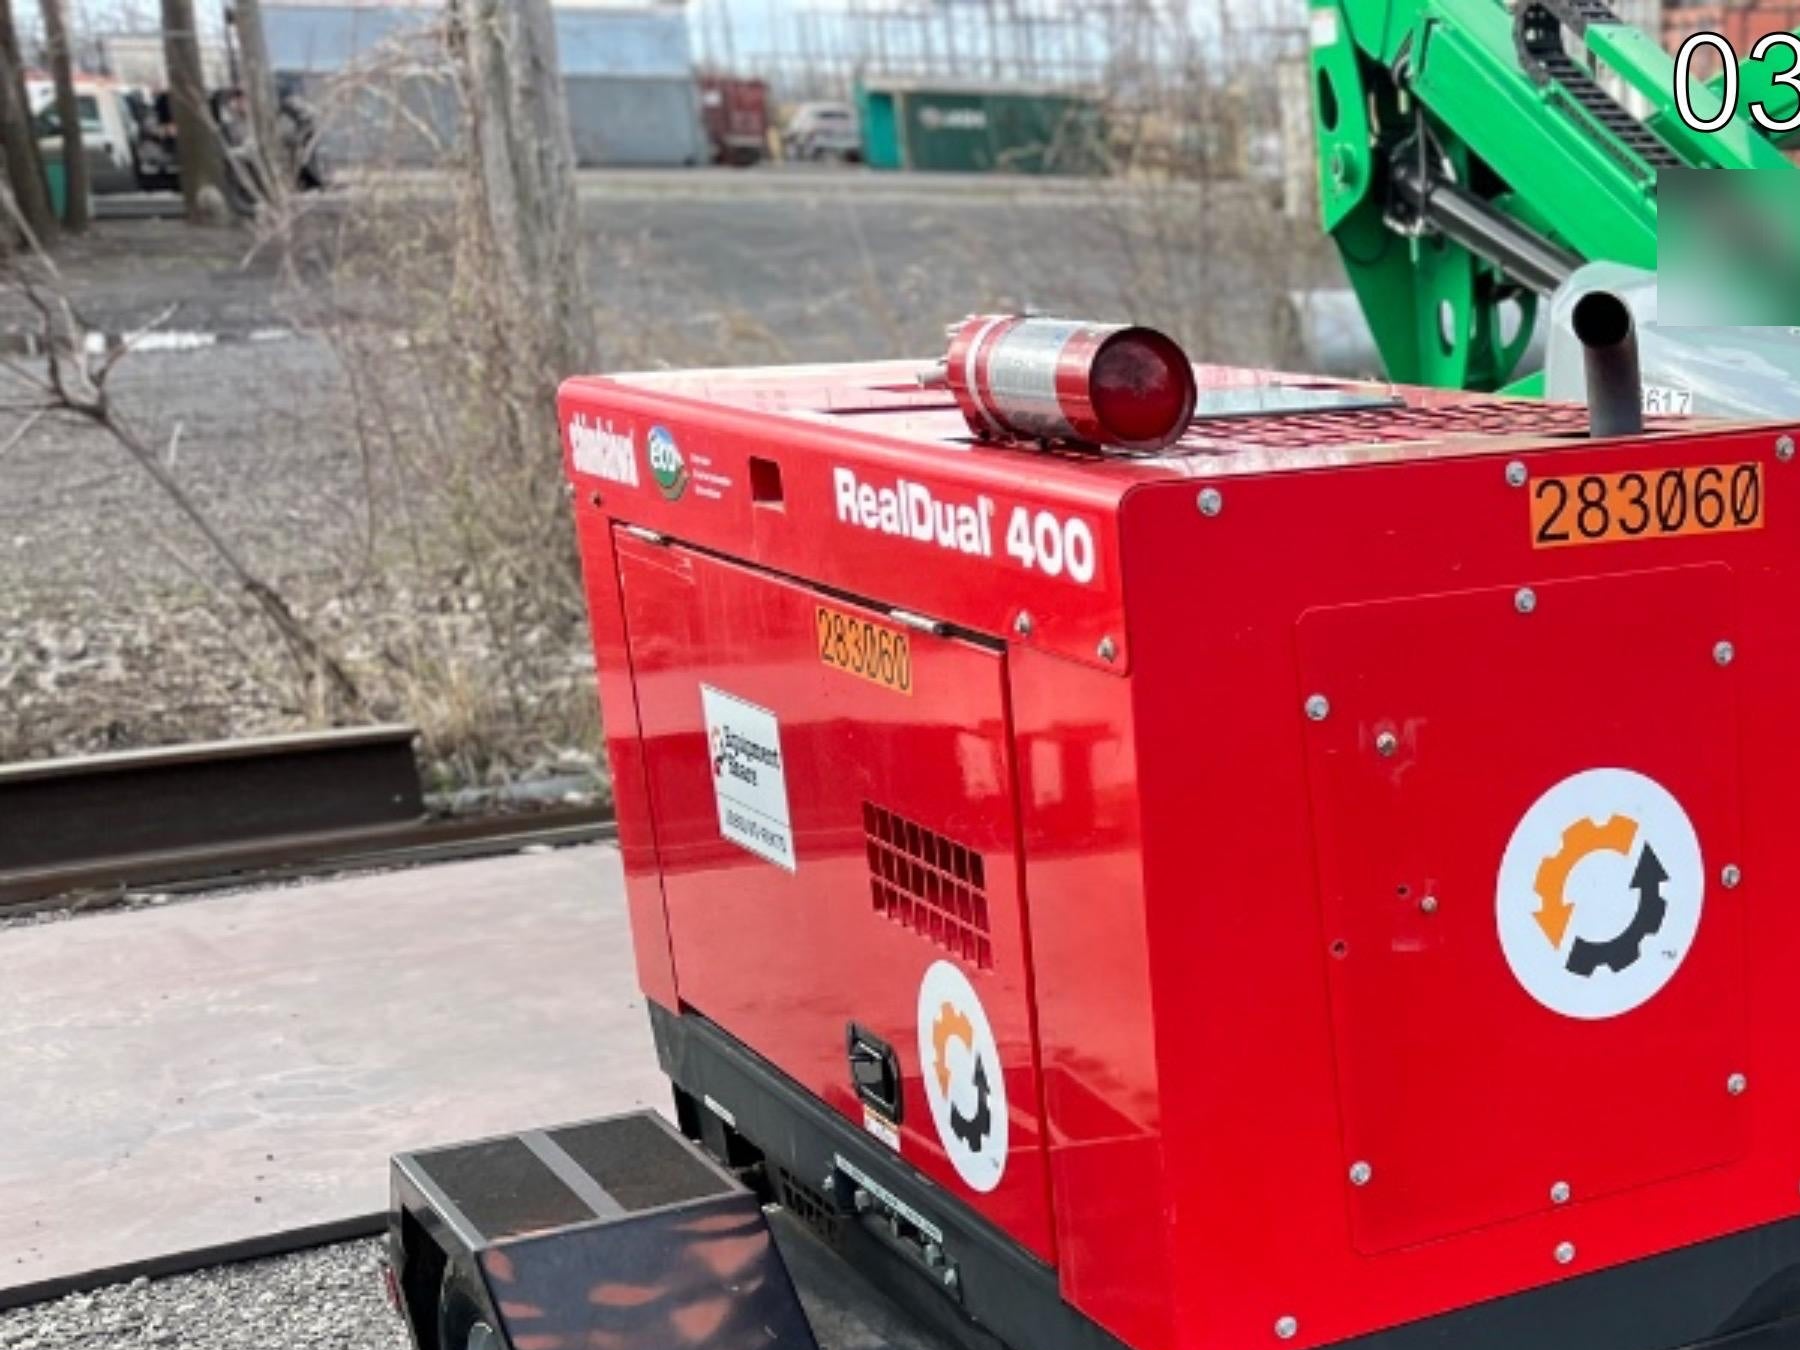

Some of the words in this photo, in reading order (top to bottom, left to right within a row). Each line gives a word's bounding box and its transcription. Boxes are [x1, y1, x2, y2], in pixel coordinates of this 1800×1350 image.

[1535, 462, 1760, 544] 283060
[1006, 505, 1095, 584] 400
[818, 607, 910, 690] 283060
